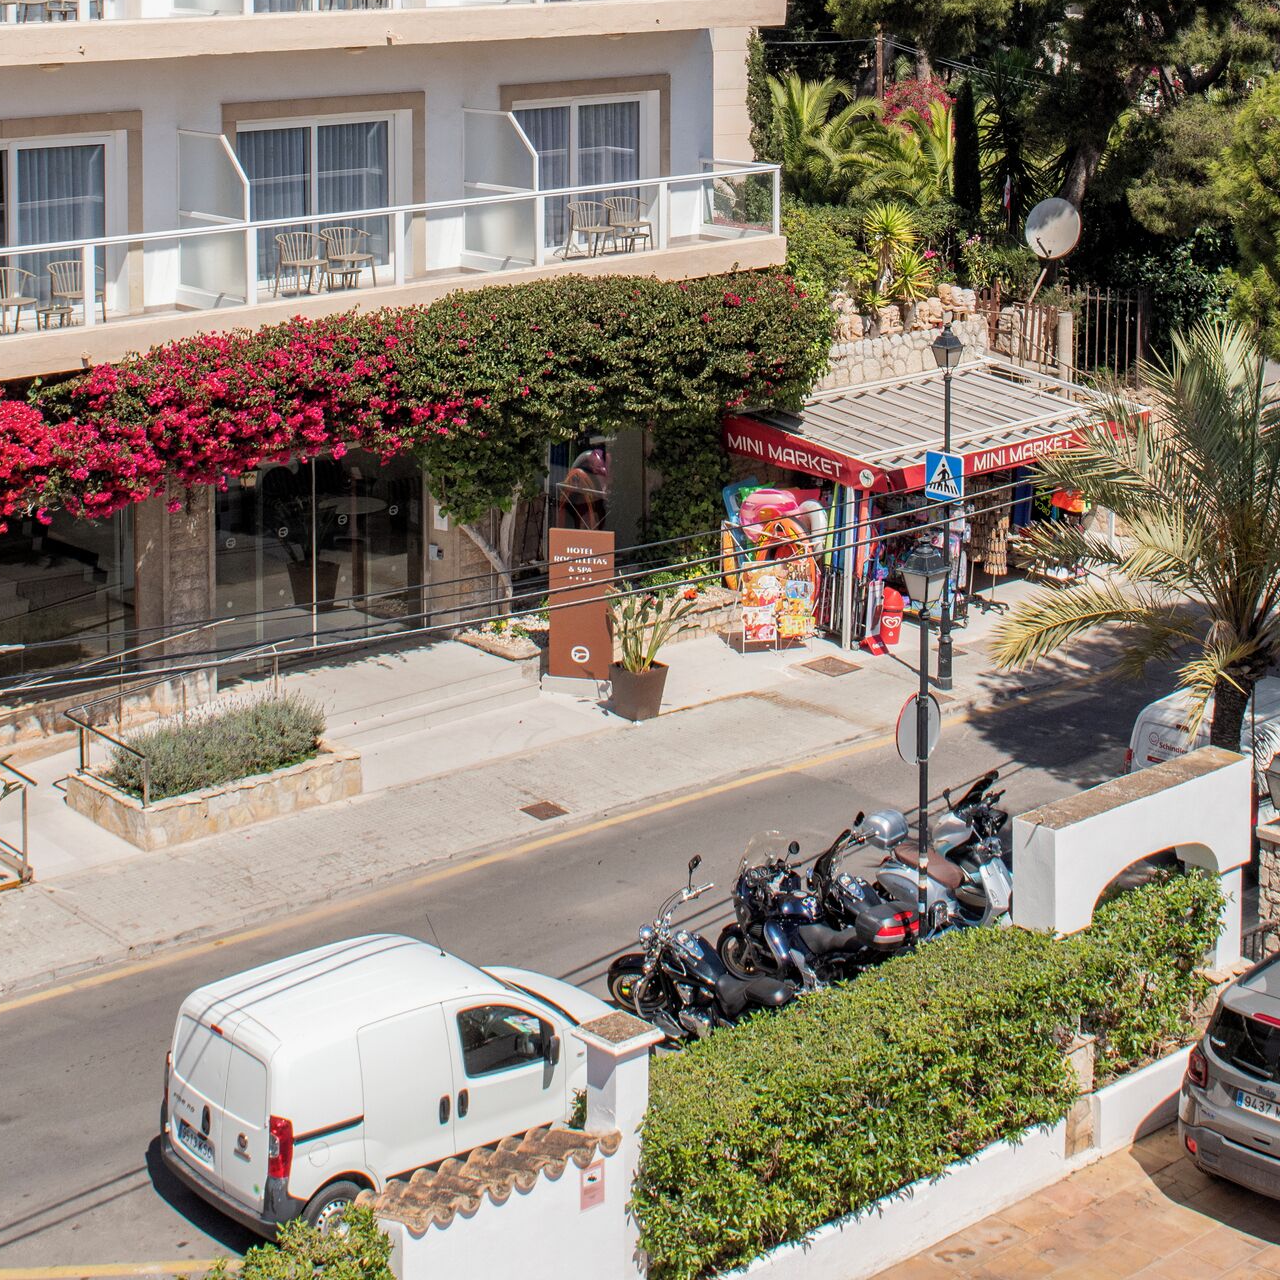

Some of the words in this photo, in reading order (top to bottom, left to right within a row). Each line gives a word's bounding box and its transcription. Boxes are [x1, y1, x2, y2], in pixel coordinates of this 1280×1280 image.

[727, 432, 764, 456] MINI
[767, 443, 843, 478] MARKET
[973, 450, 1006, 472] MINI
[1009, 433, 1073, 463] MARKET
[566, 547, 593, 555] HOTEL
[577, 566, 593, 574] SPA
[1244, 1095, 1272, 1116] 9437
